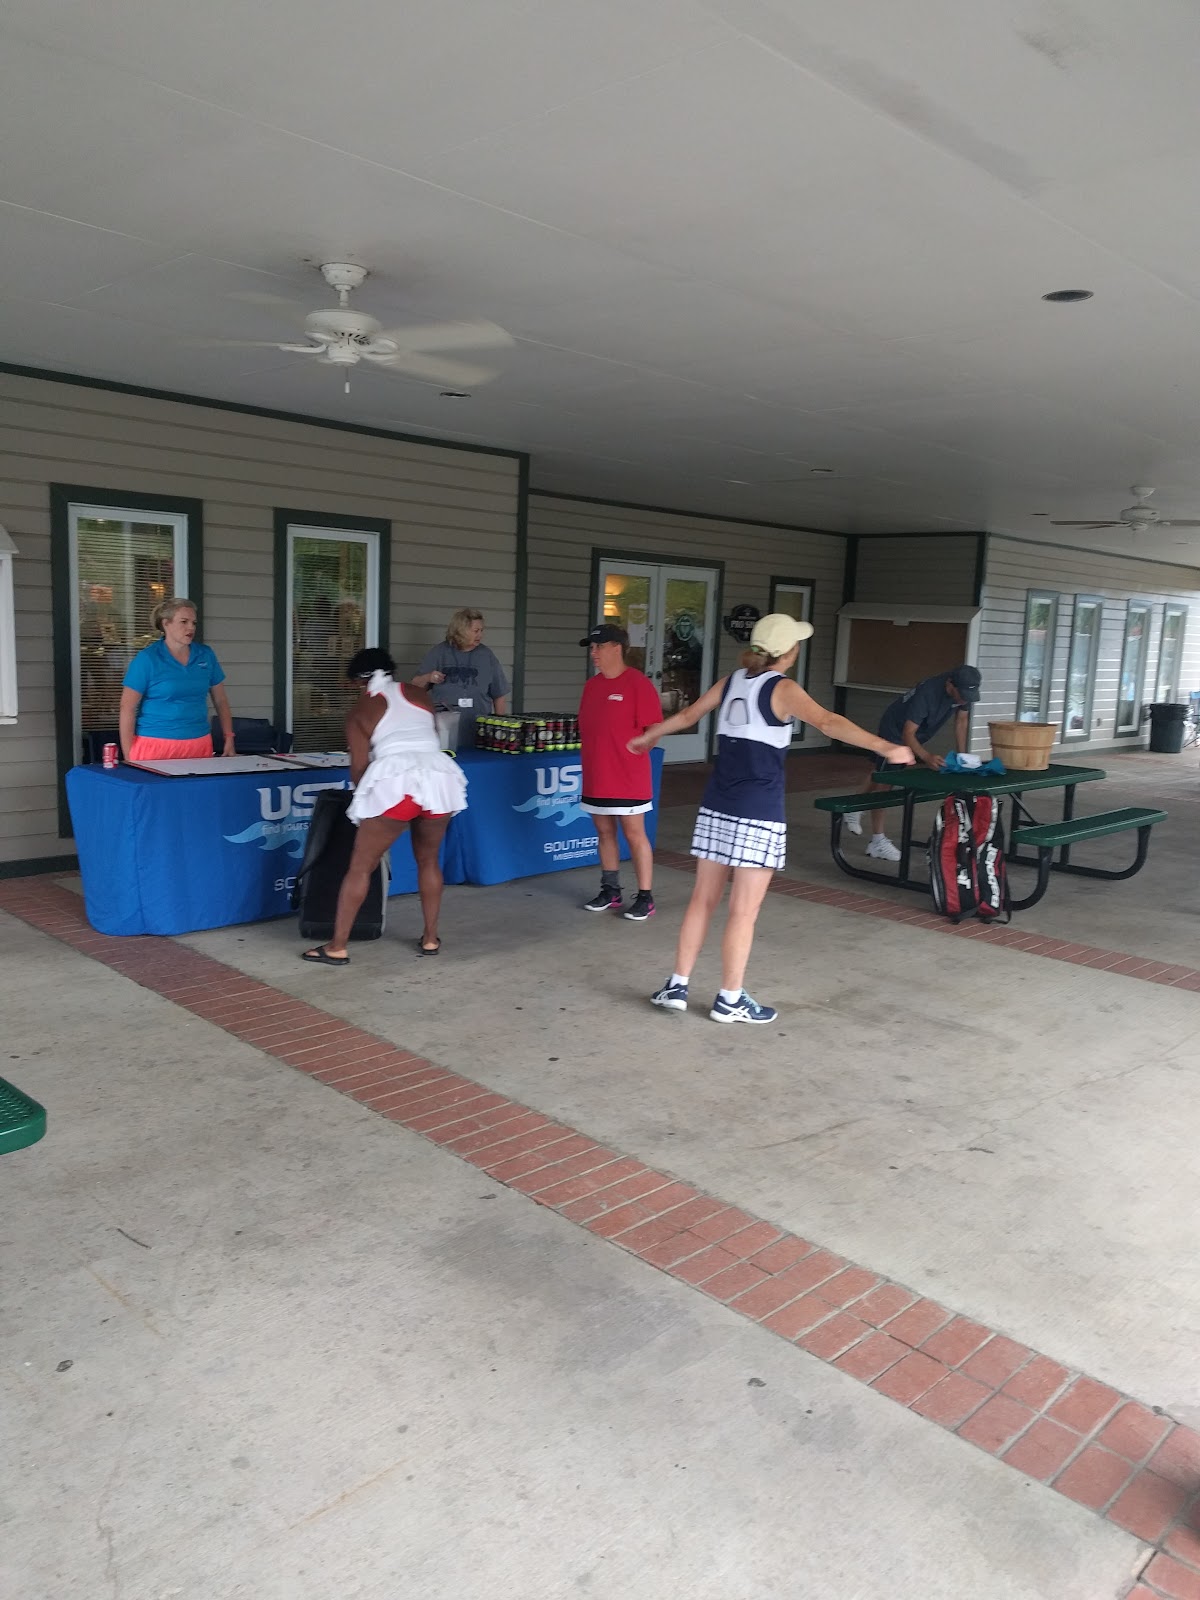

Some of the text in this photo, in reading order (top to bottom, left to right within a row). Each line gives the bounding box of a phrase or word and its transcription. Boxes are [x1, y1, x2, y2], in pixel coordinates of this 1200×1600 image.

[534, 765, 582, 794] US
[281, 822, 311, 835] yours
[543, 836, 599, 853] SOUTHER
[553, 848, 597, 861] MISSISSIPPI
